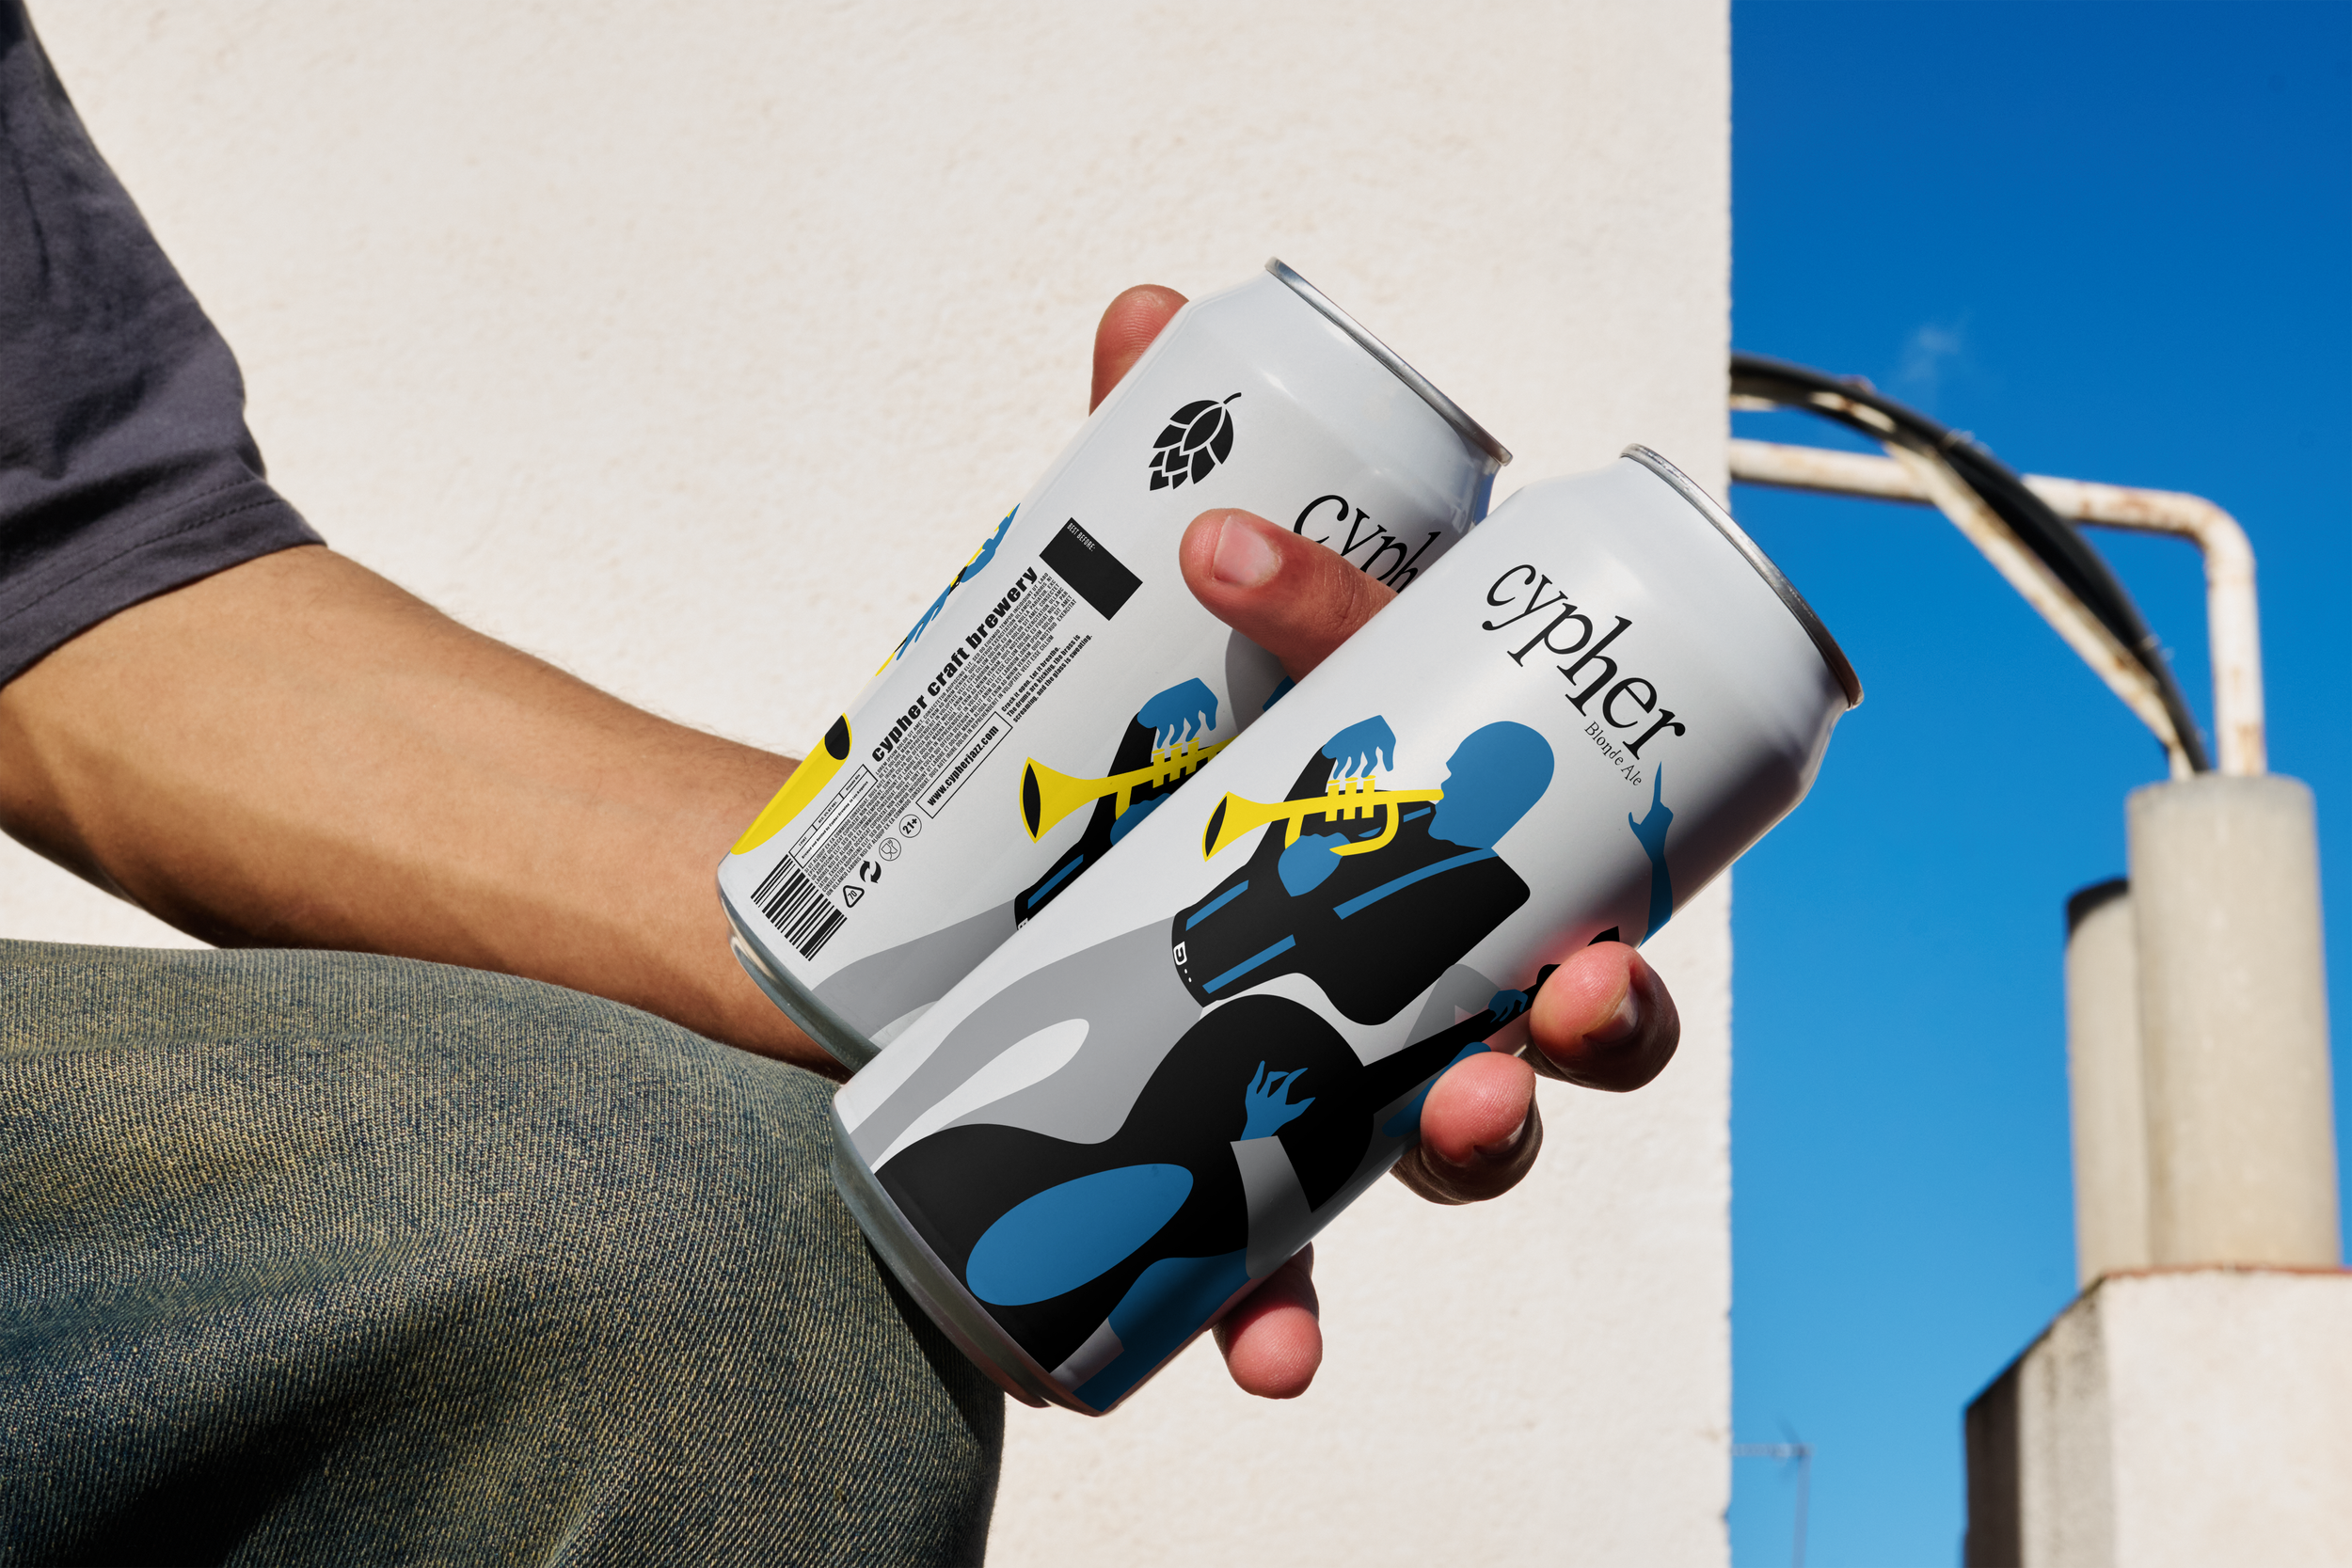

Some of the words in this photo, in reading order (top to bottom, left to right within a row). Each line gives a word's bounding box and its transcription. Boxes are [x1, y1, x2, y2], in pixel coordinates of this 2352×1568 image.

[1067, 523, 1079, 535] BEST
[1077, 532, 1095, 551] BEFORE:
[872, 695, 927, 762] cypher
[928, 648, 970, 696] craft
[965, 567, 1037, 649] brewery
[1001, 696, 1016, 712] Crack
[1018, 680, 1032, 693] open.
[1029, 671, 1039, 680] Let
[1040, 647, 1060, 668] breathe.
[1007, 706, 1017, 717] The
[1015, 691, 1031, 708] drums
[1029, 683, 1039, 692] are
[1053, 655, 1063, 664] the
[1060, 641, 1075, 656] brass
[1037, 685, 1047, 696] and
[1044, 676, 1055, 687] the
[1053, 663, 1067, 678] glass
[1070, 635, 1092, 658] sweating.
[1482, 564, 1686, 759] cypher
[928, 726, 998, 805] www.cypherjazz.com
[1584, 721, 1624, 766] Blonde
[1621, 765, 1642, 786] Ale
[902, 818, 917, 834] 21+
[848, 890, 858, 900] 70
